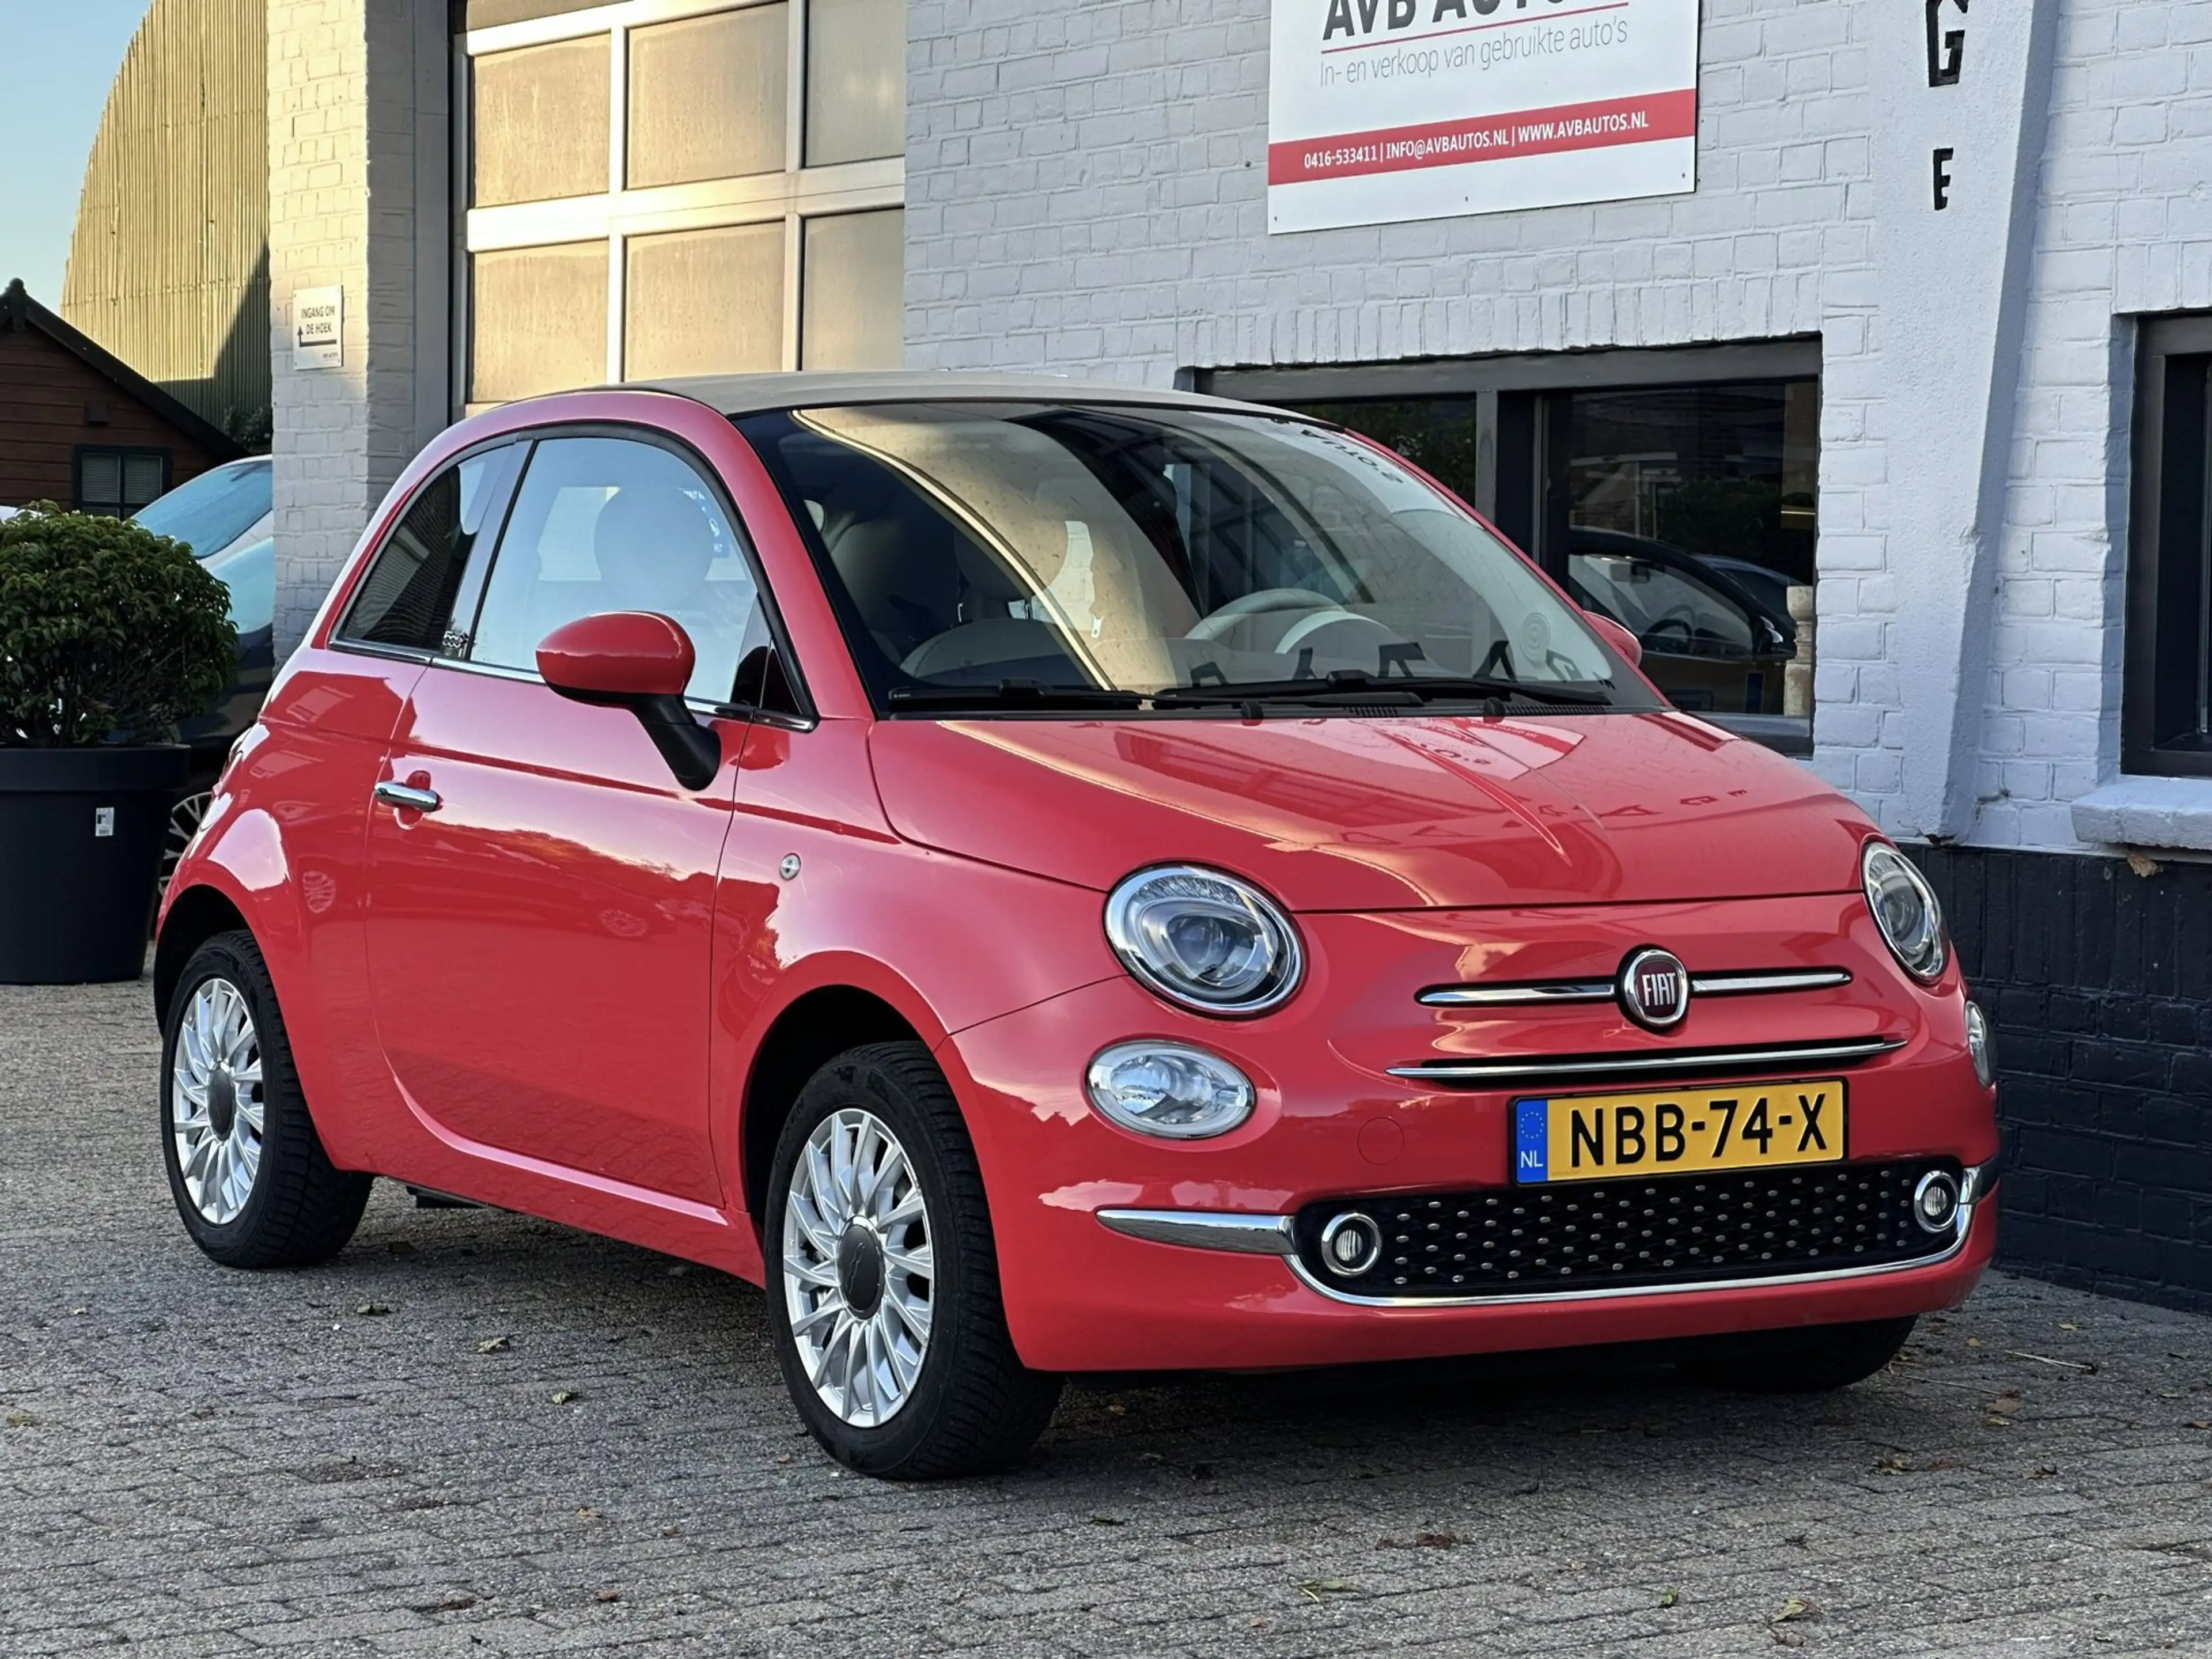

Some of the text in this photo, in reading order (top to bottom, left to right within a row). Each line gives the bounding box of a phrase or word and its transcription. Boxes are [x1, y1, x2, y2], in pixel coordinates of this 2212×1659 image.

[1320, 16, 1628, 86] In- en verkoop van gebruikte auto's
[1304, 145, 1377, 168] 0416-533411
[1385, 131, 1509, 160] INFO@AVBAUTOS.NL
[1518, 111, 1649, 143] WWW.AVBAUTOS.NL
[301, 305, 335, 319] INGANG OM
[306, 321, 332, 334] DE HOEK
[1642, 972, 1676, 1007] FIAT
[1571, 1093, 1827, 1168] NBB-74-X
[1521, 1151, 1543, 1168] NL
